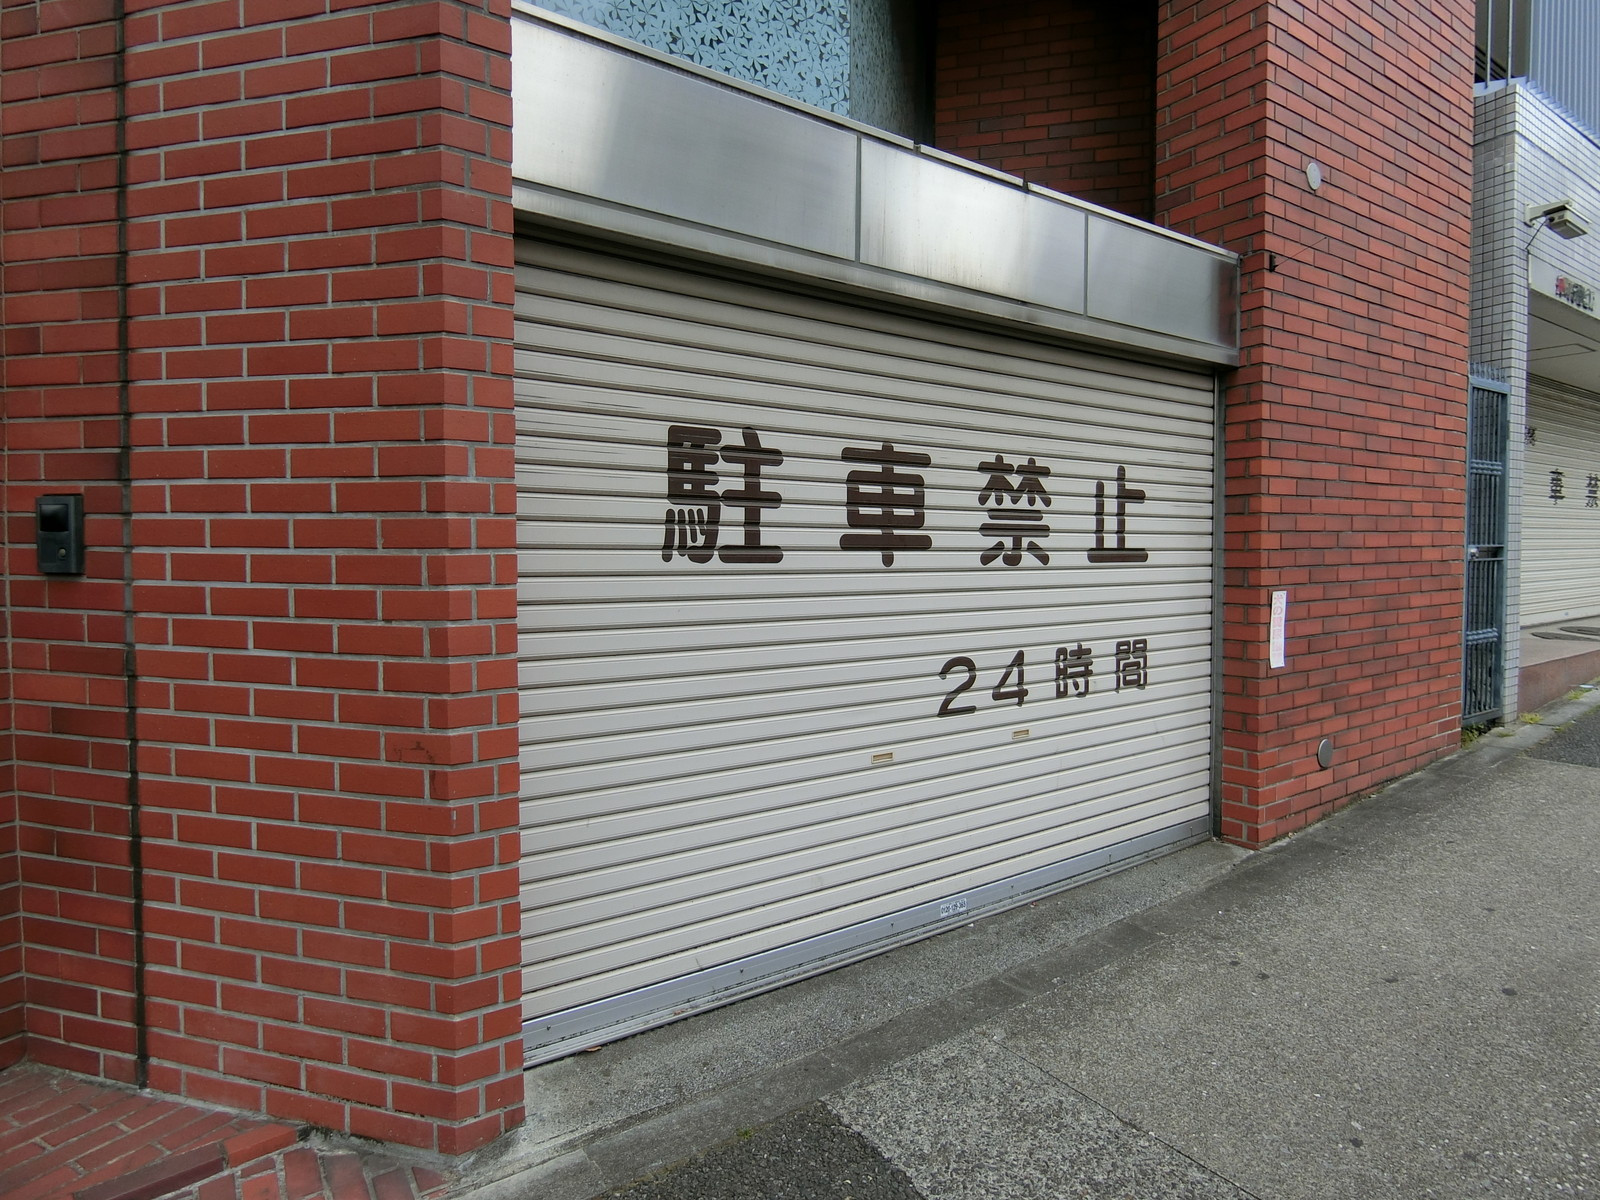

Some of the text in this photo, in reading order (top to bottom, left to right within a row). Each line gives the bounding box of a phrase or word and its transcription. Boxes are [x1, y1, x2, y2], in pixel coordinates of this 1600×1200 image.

[662, 424, 1148, 567] 駐車禁止
[938, 637, 1148, 718] 24時間
